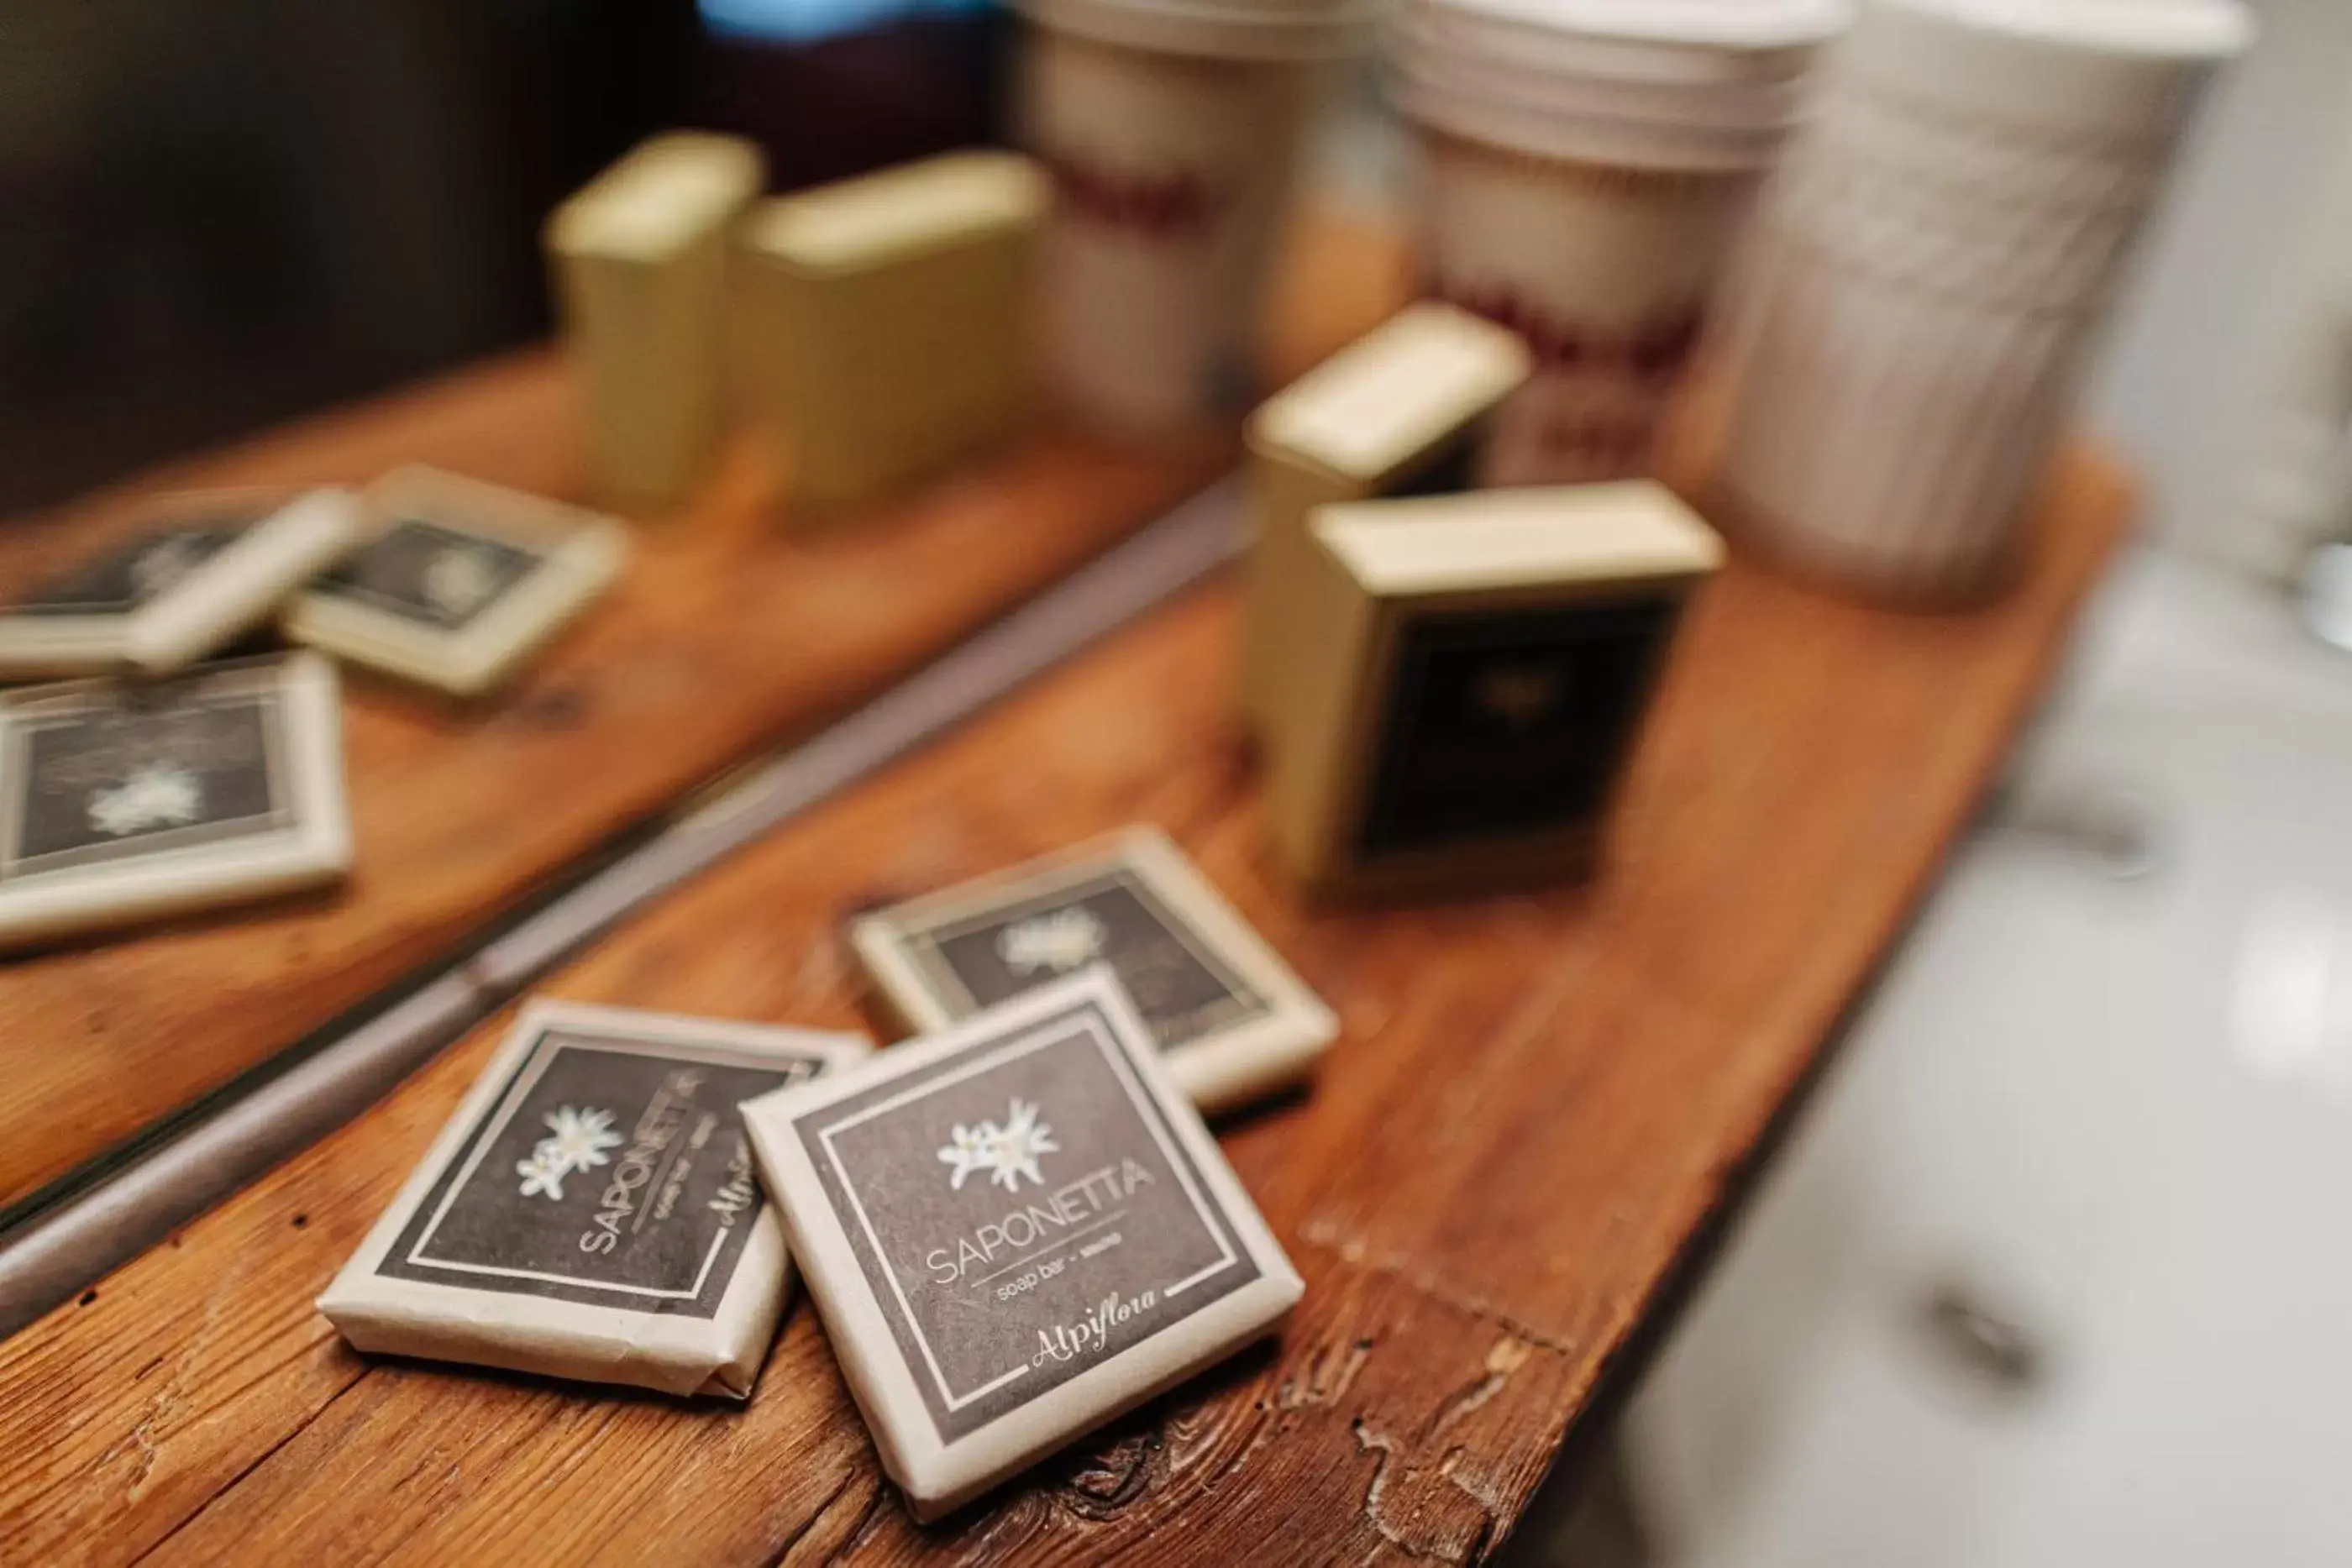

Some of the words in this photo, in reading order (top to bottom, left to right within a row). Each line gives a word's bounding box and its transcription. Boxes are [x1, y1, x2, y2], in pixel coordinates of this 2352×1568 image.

[926, 1156, 1157, 1284] SAPONETTA
[996, 1272, 1038, 1301] soap
[1036, 1257, 1065, 1280] bar
[1032, 1291, 1156, 1367] Alpiflora
